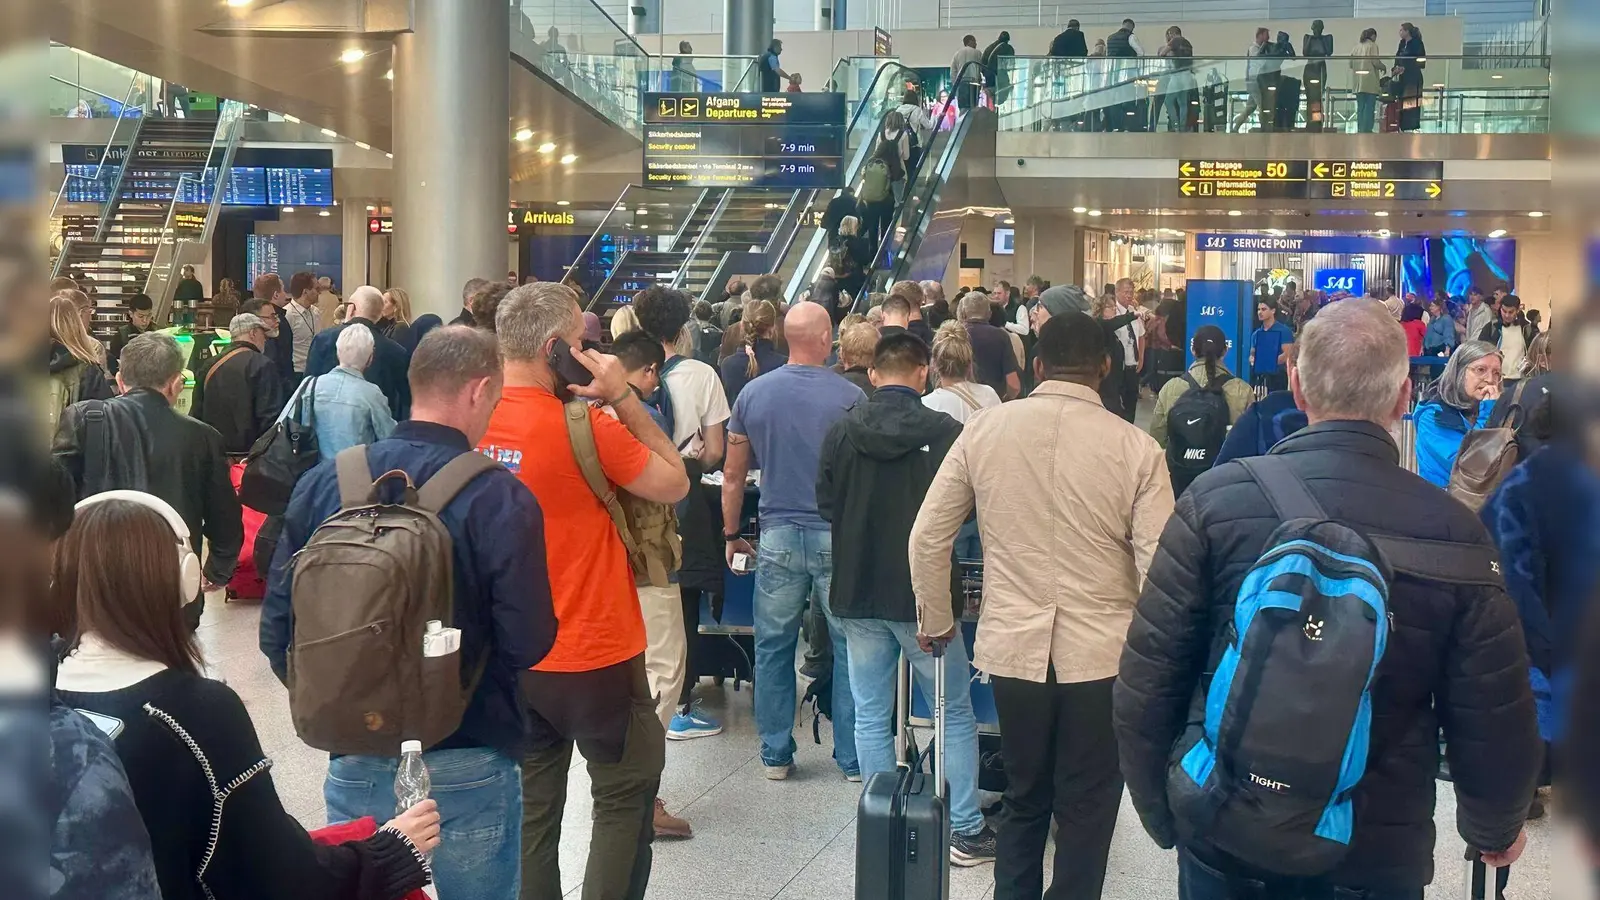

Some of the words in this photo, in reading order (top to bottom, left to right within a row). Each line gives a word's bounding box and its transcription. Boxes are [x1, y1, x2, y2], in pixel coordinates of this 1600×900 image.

[706, 97, 740, 108] Afgang
[705, 108, 758, 119] Departures
[648, 143, 673, 151] Security
[780, 143, 796, 152] 7-9
[798, 143, 815, 152] min
[780, 164, 796, 173] 7-9
[798, 164, 815, 173] min
[1200, 161, 1215, 169] Stor
[1216, 161, 1242, 170] bagage
[1266, 163, 1287, 177] 50
[1350, 162, 1382, 170] Ankomst
[1200, 169, 1230, 177] Odd-size
[1231, 169, 1262, 178] baggage
[1350, 170, 1378, 178] Arrivals
[1384, 183, 1395, 197] 2
[523, 211, 575, 224] Arrivals
[1205, 237, 1227, 248] SAS
[1233, 238, 1272, 249] SERVICE
[1273, 239, 1303, 249] POINT
[1323, 276, 1357, 290] SAS
[1200, 306, 1217, 316] SAS
[1183, 448, 1206, 460] NIKE
[1249, 772, 1291, 790] TIGHT
